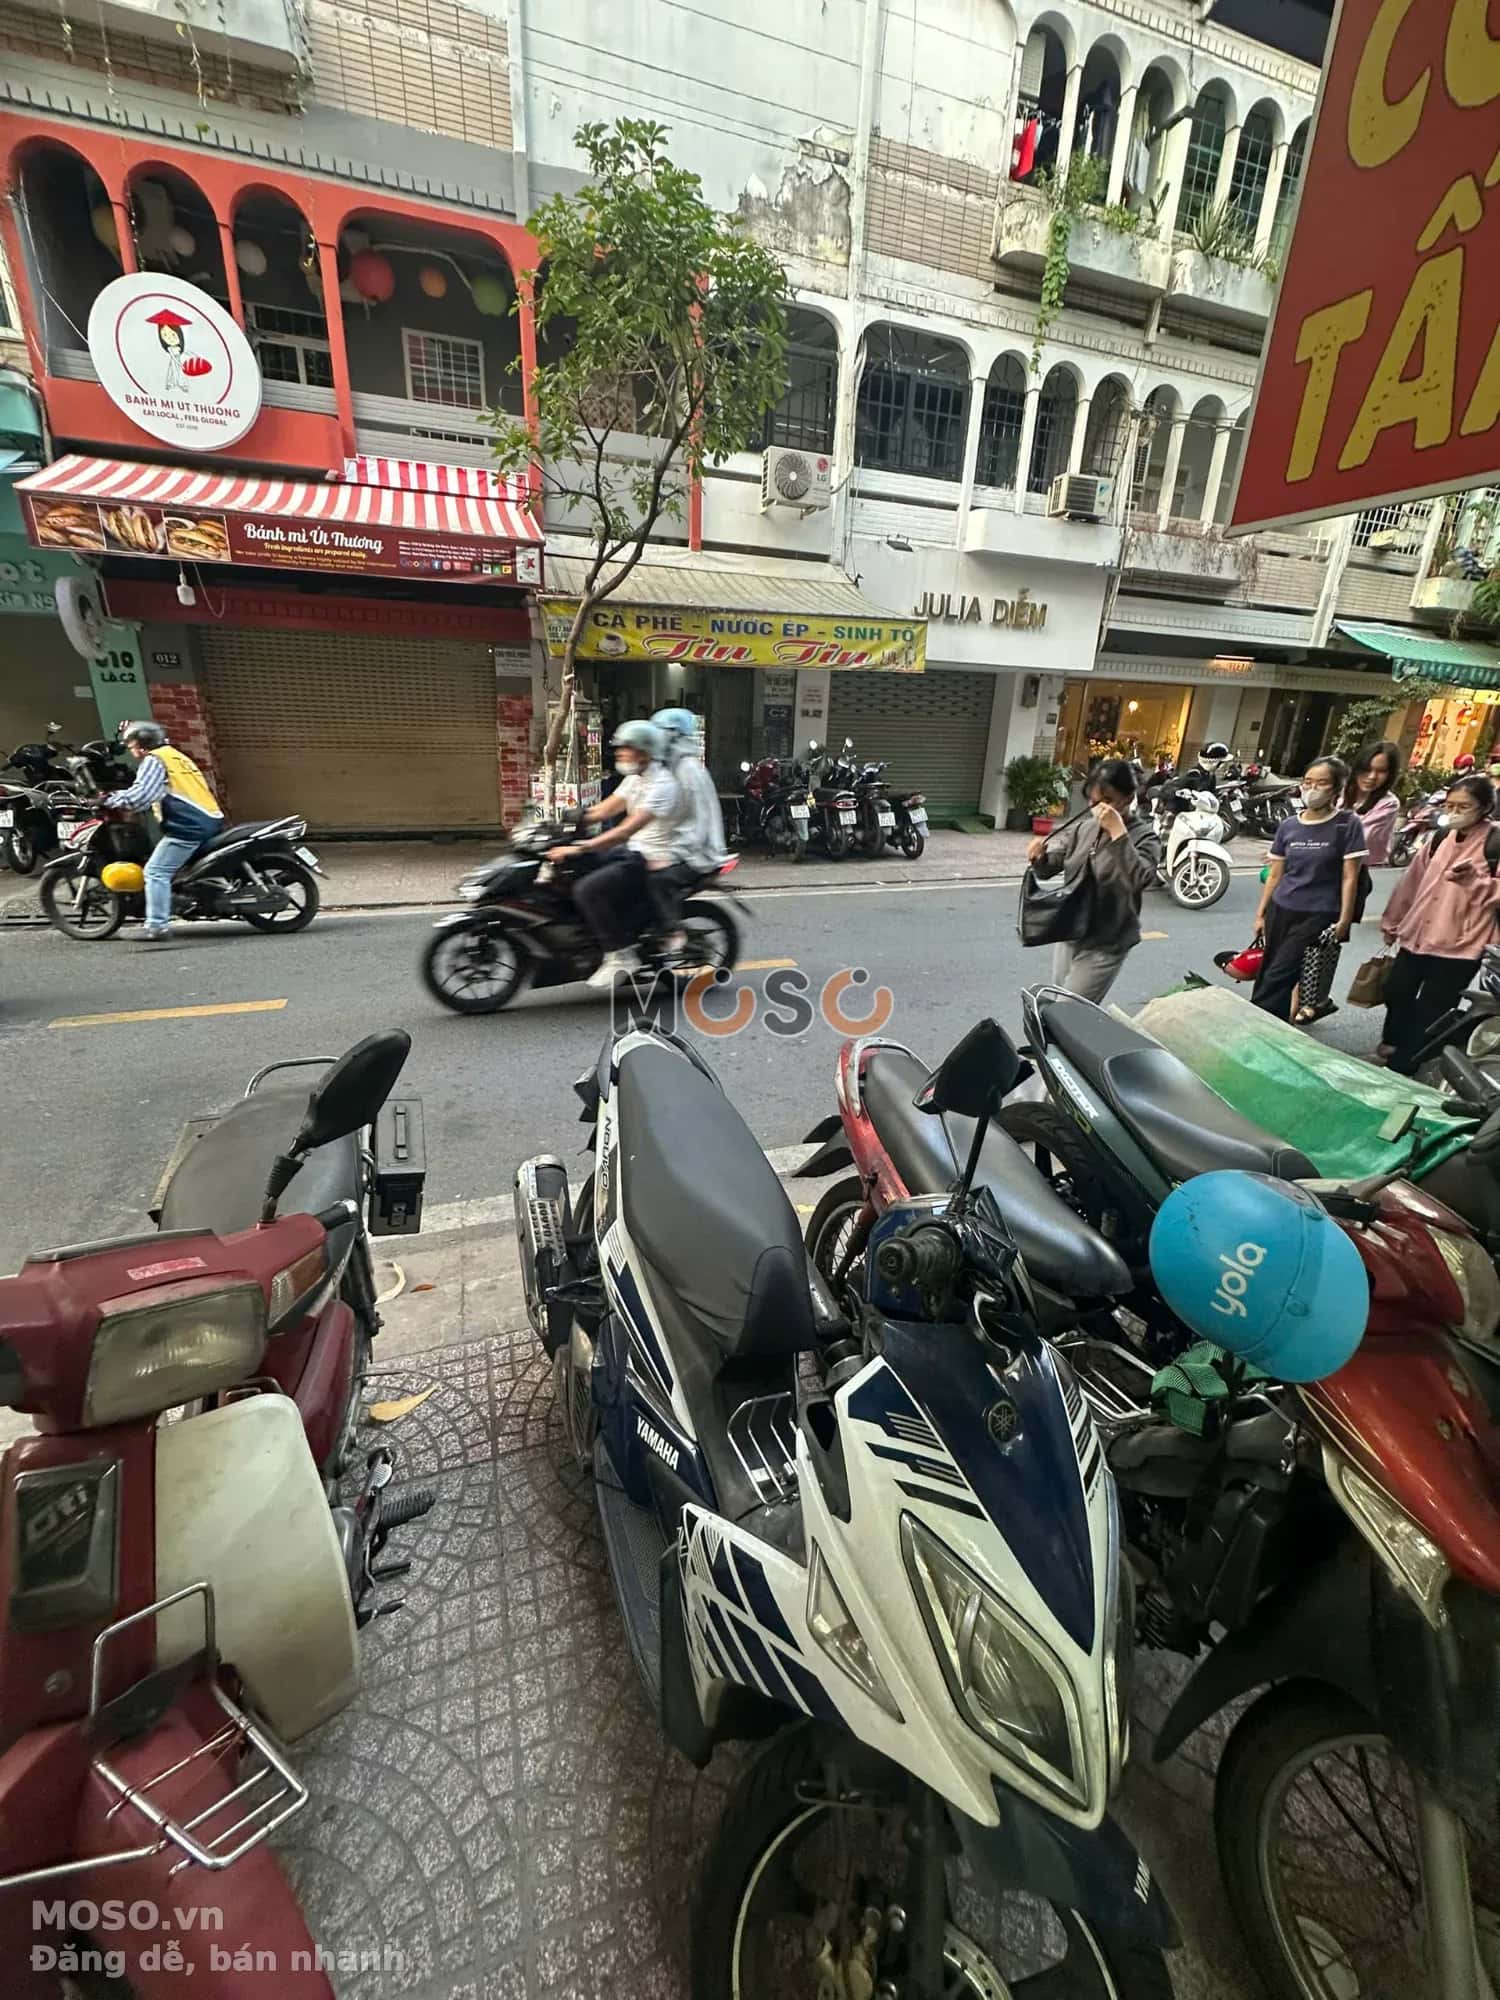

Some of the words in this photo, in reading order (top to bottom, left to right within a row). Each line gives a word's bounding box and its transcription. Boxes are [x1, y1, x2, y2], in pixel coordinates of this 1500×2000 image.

[1347, 0, 1500, 169] C
[125, 394, 157, 407] BANH
[161, 399, 174, 409] MI
[177, 402, 191, 411] UT
[194, 403, 240, 418] THUONG
[244, 523, 286, 541] Bánh
[288, 527, 308, 544] mì
[331, 532, 384, 554] Thương
[914, 591, 982, 622] JULIA
[636, 609, 683, 631] PHÊ
[711, 615, 773, 635] NƯỚC
[782, 620, 809, 638] ÉP
[833, 625, 882, 641] SINH
[642, 632, 757, 663] Tin
[773, 639, 880, 667] Tin
[1210, 1242, 1267, 1317] yola
[637, 1415, 679, 1471] YAMAHA
